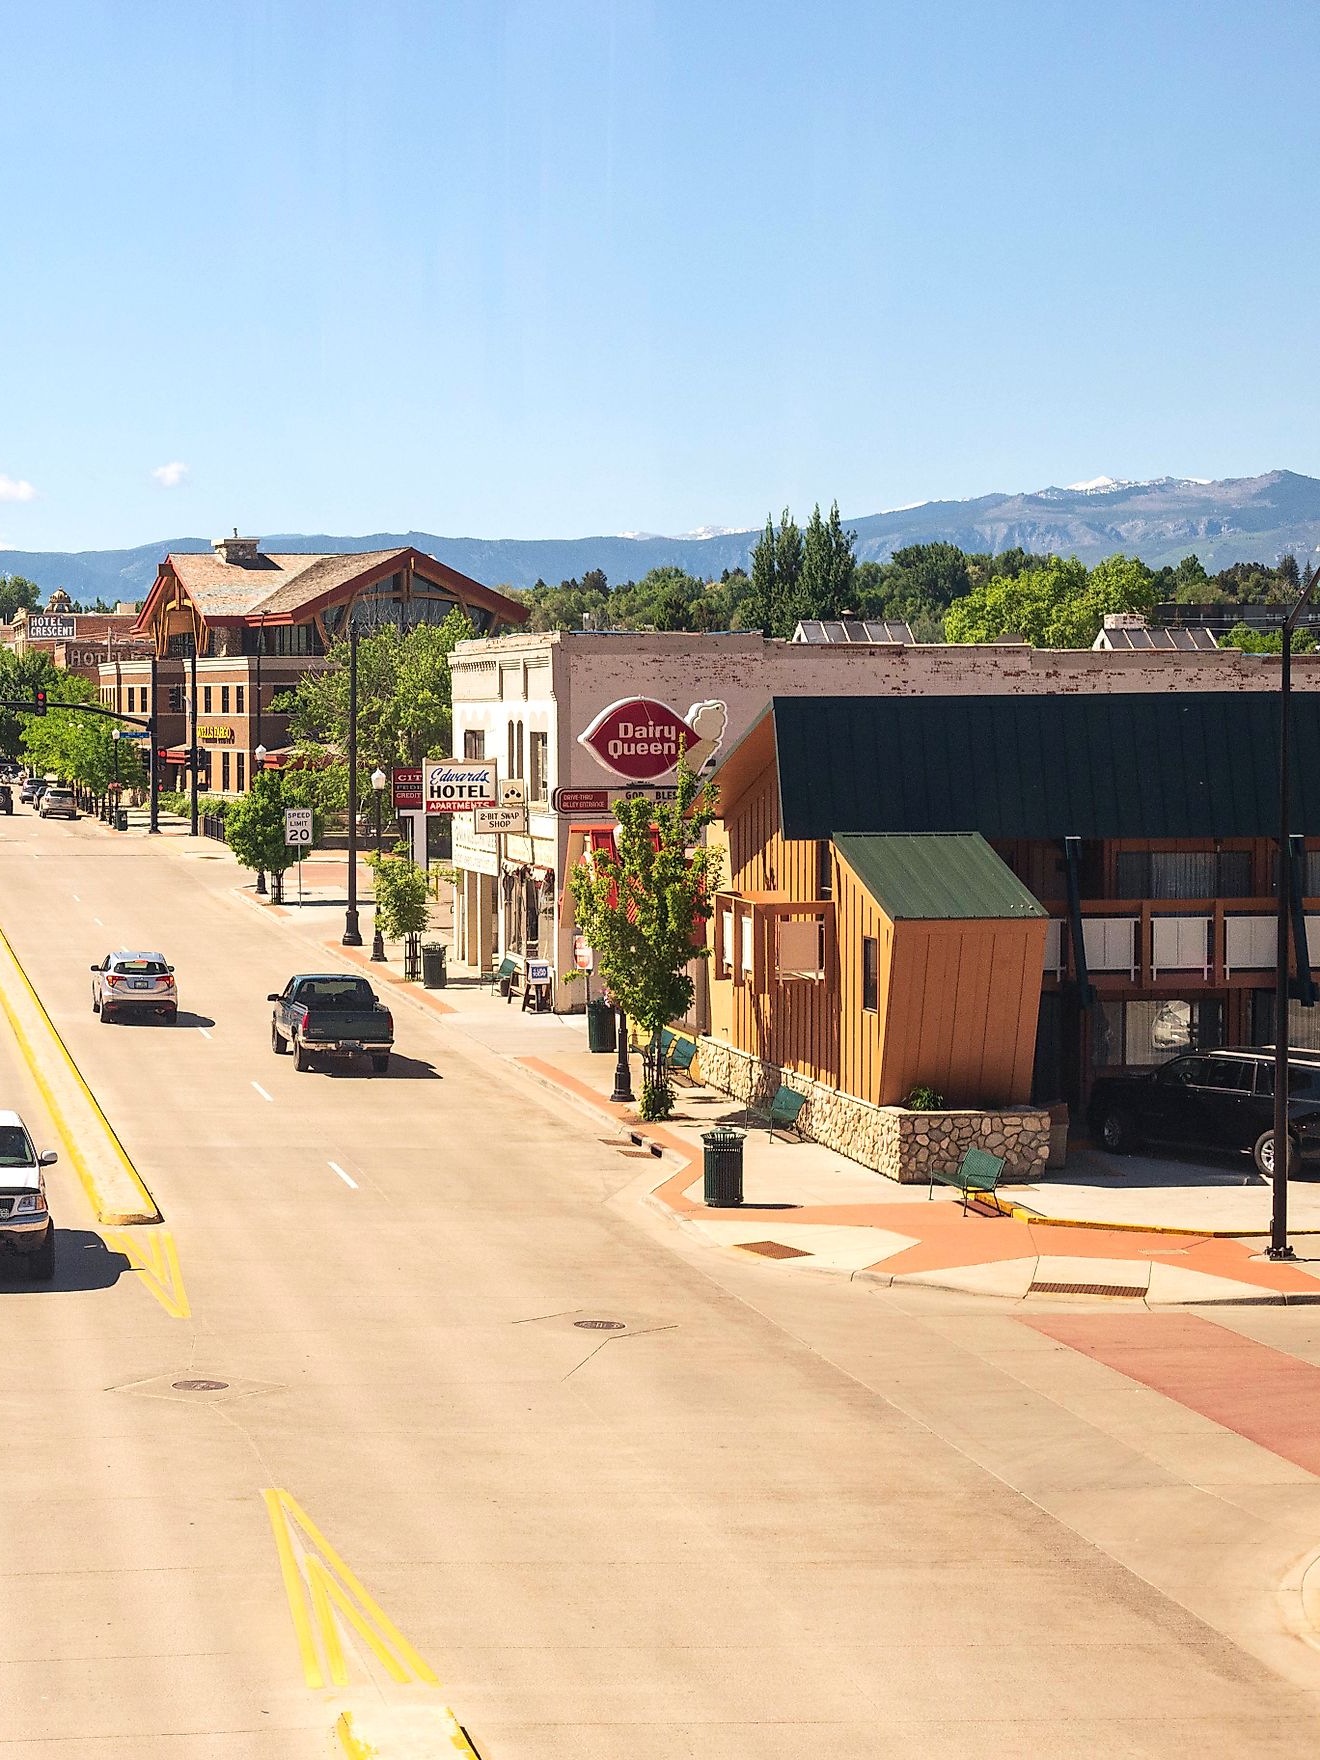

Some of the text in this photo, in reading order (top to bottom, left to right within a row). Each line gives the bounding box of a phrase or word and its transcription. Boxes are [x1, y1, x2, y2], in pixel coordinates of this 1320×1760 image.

[31, 617, 63, 627] HOTEL
[31, 626, 74, 637] CRESCENT
[213, 726, 231, 739] FARGO
[618, 721, 676, 741] Dairy
[607, 740, 676, 759] Queen
[397, 774, 423, 782] CIT
[430, 767, 490, 785] Edwards
[429, 784, 490, 798] HOTEL
[625, 791, 678, 800] GOD BLES
[480, 811, 520, 821] 2-BIT SWAP
[488, 820, 511, 828] SHOP
[289, 829, 310, 841] 20
